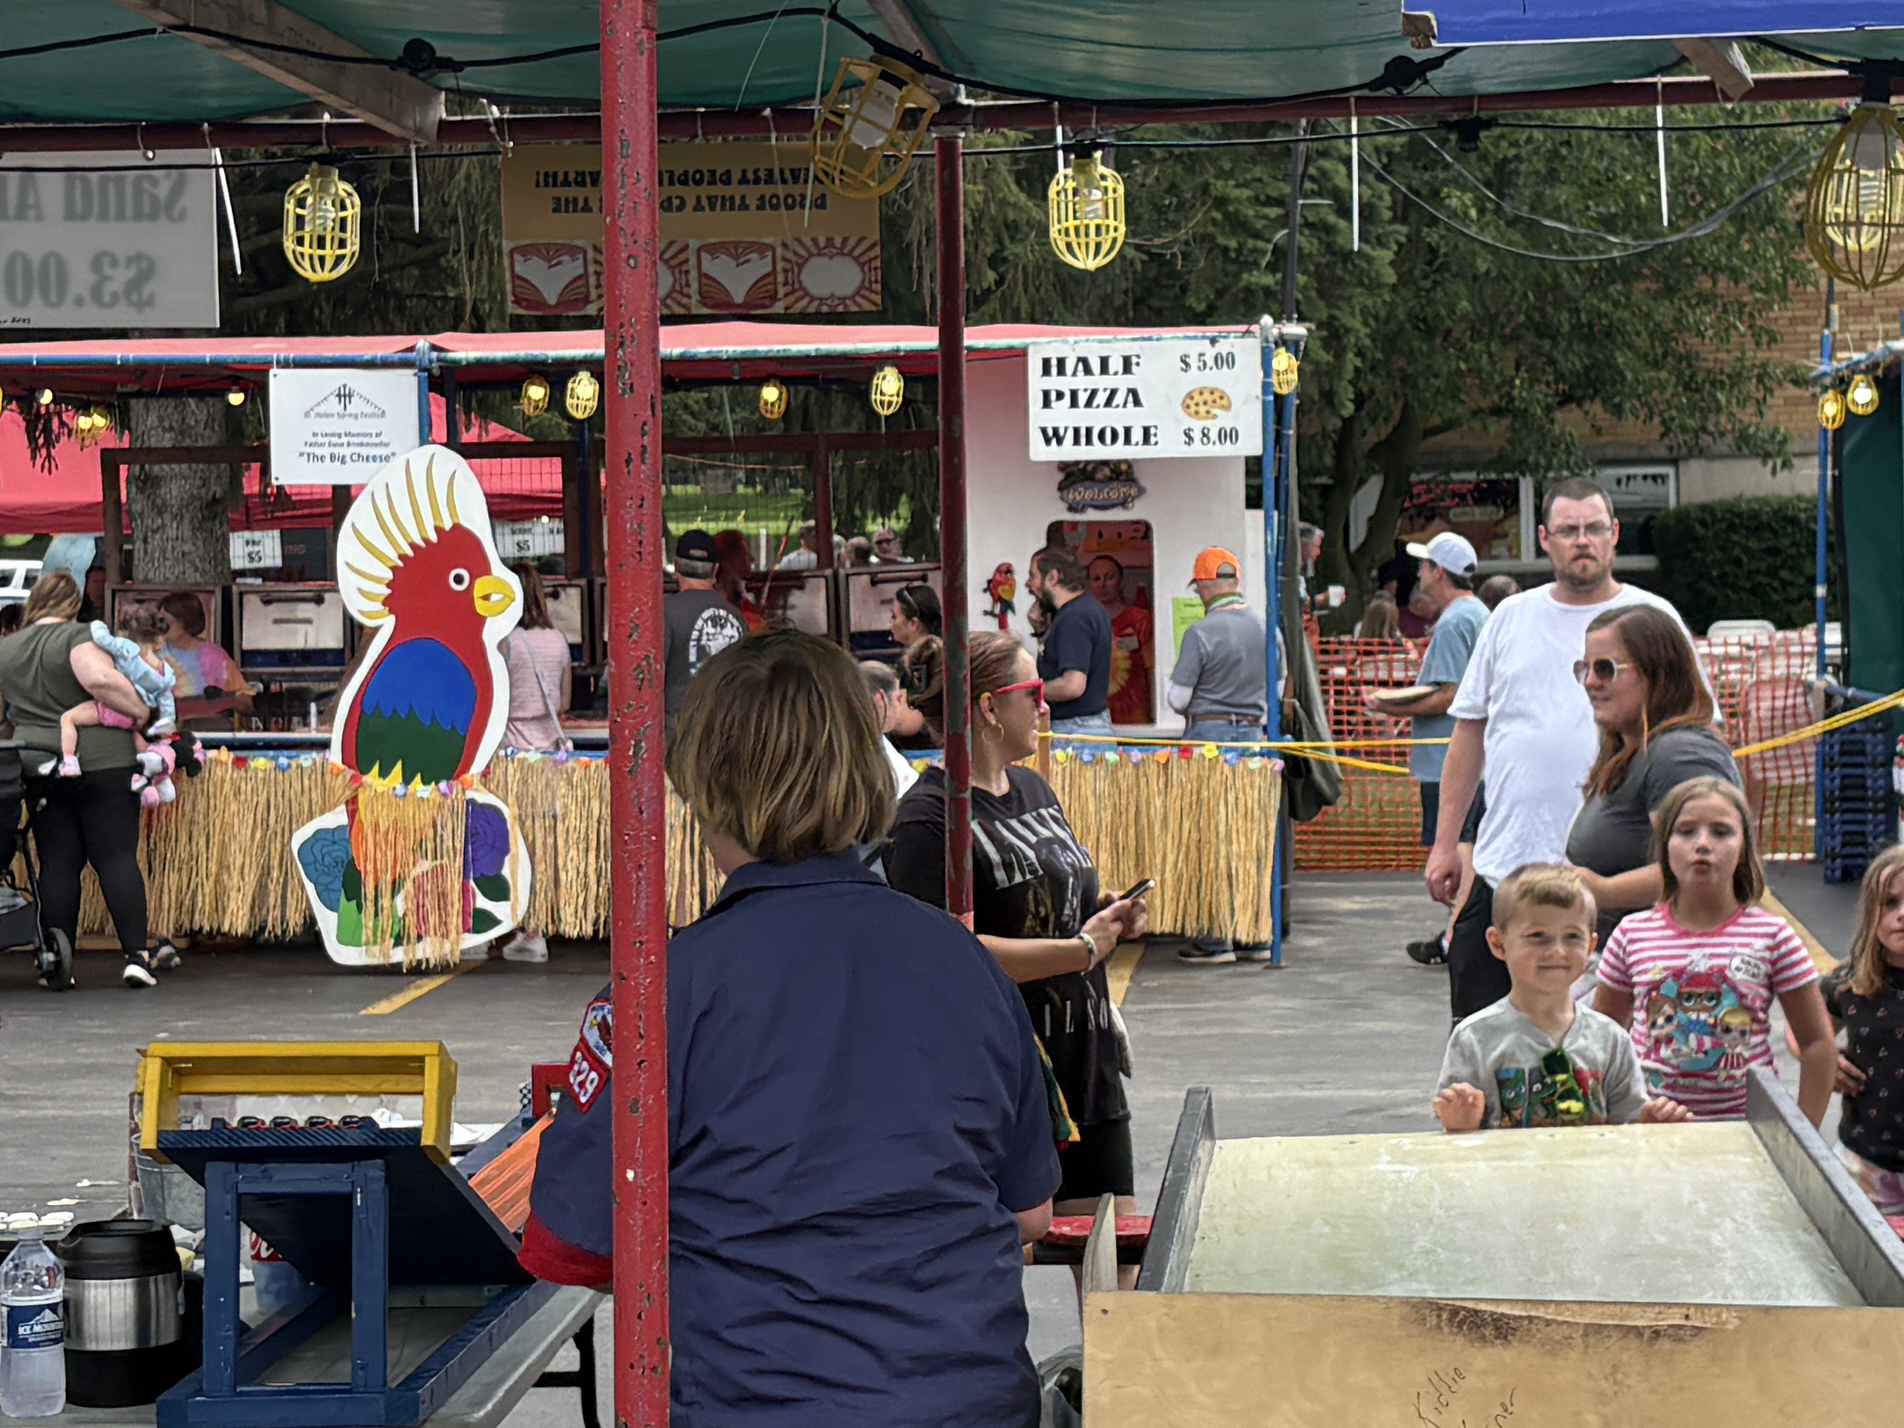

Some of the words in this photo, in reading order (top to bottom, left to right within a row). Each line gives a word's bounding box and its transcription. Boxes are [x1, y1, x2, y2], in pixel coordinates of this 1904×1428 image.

[535, 169, 603, 188] ARTH!
[738, 167, 844, 186] EATEST
[551, 196, 594, 214] THE
[692, 194, 751, 213] THAT
[755, 193, 827, 211] PROOF
[1040, 354, 1141, 378] HALF
[1040, 387, 1144, 410] PIZZA
[1039, 425, 1159, 448] WHOLE
